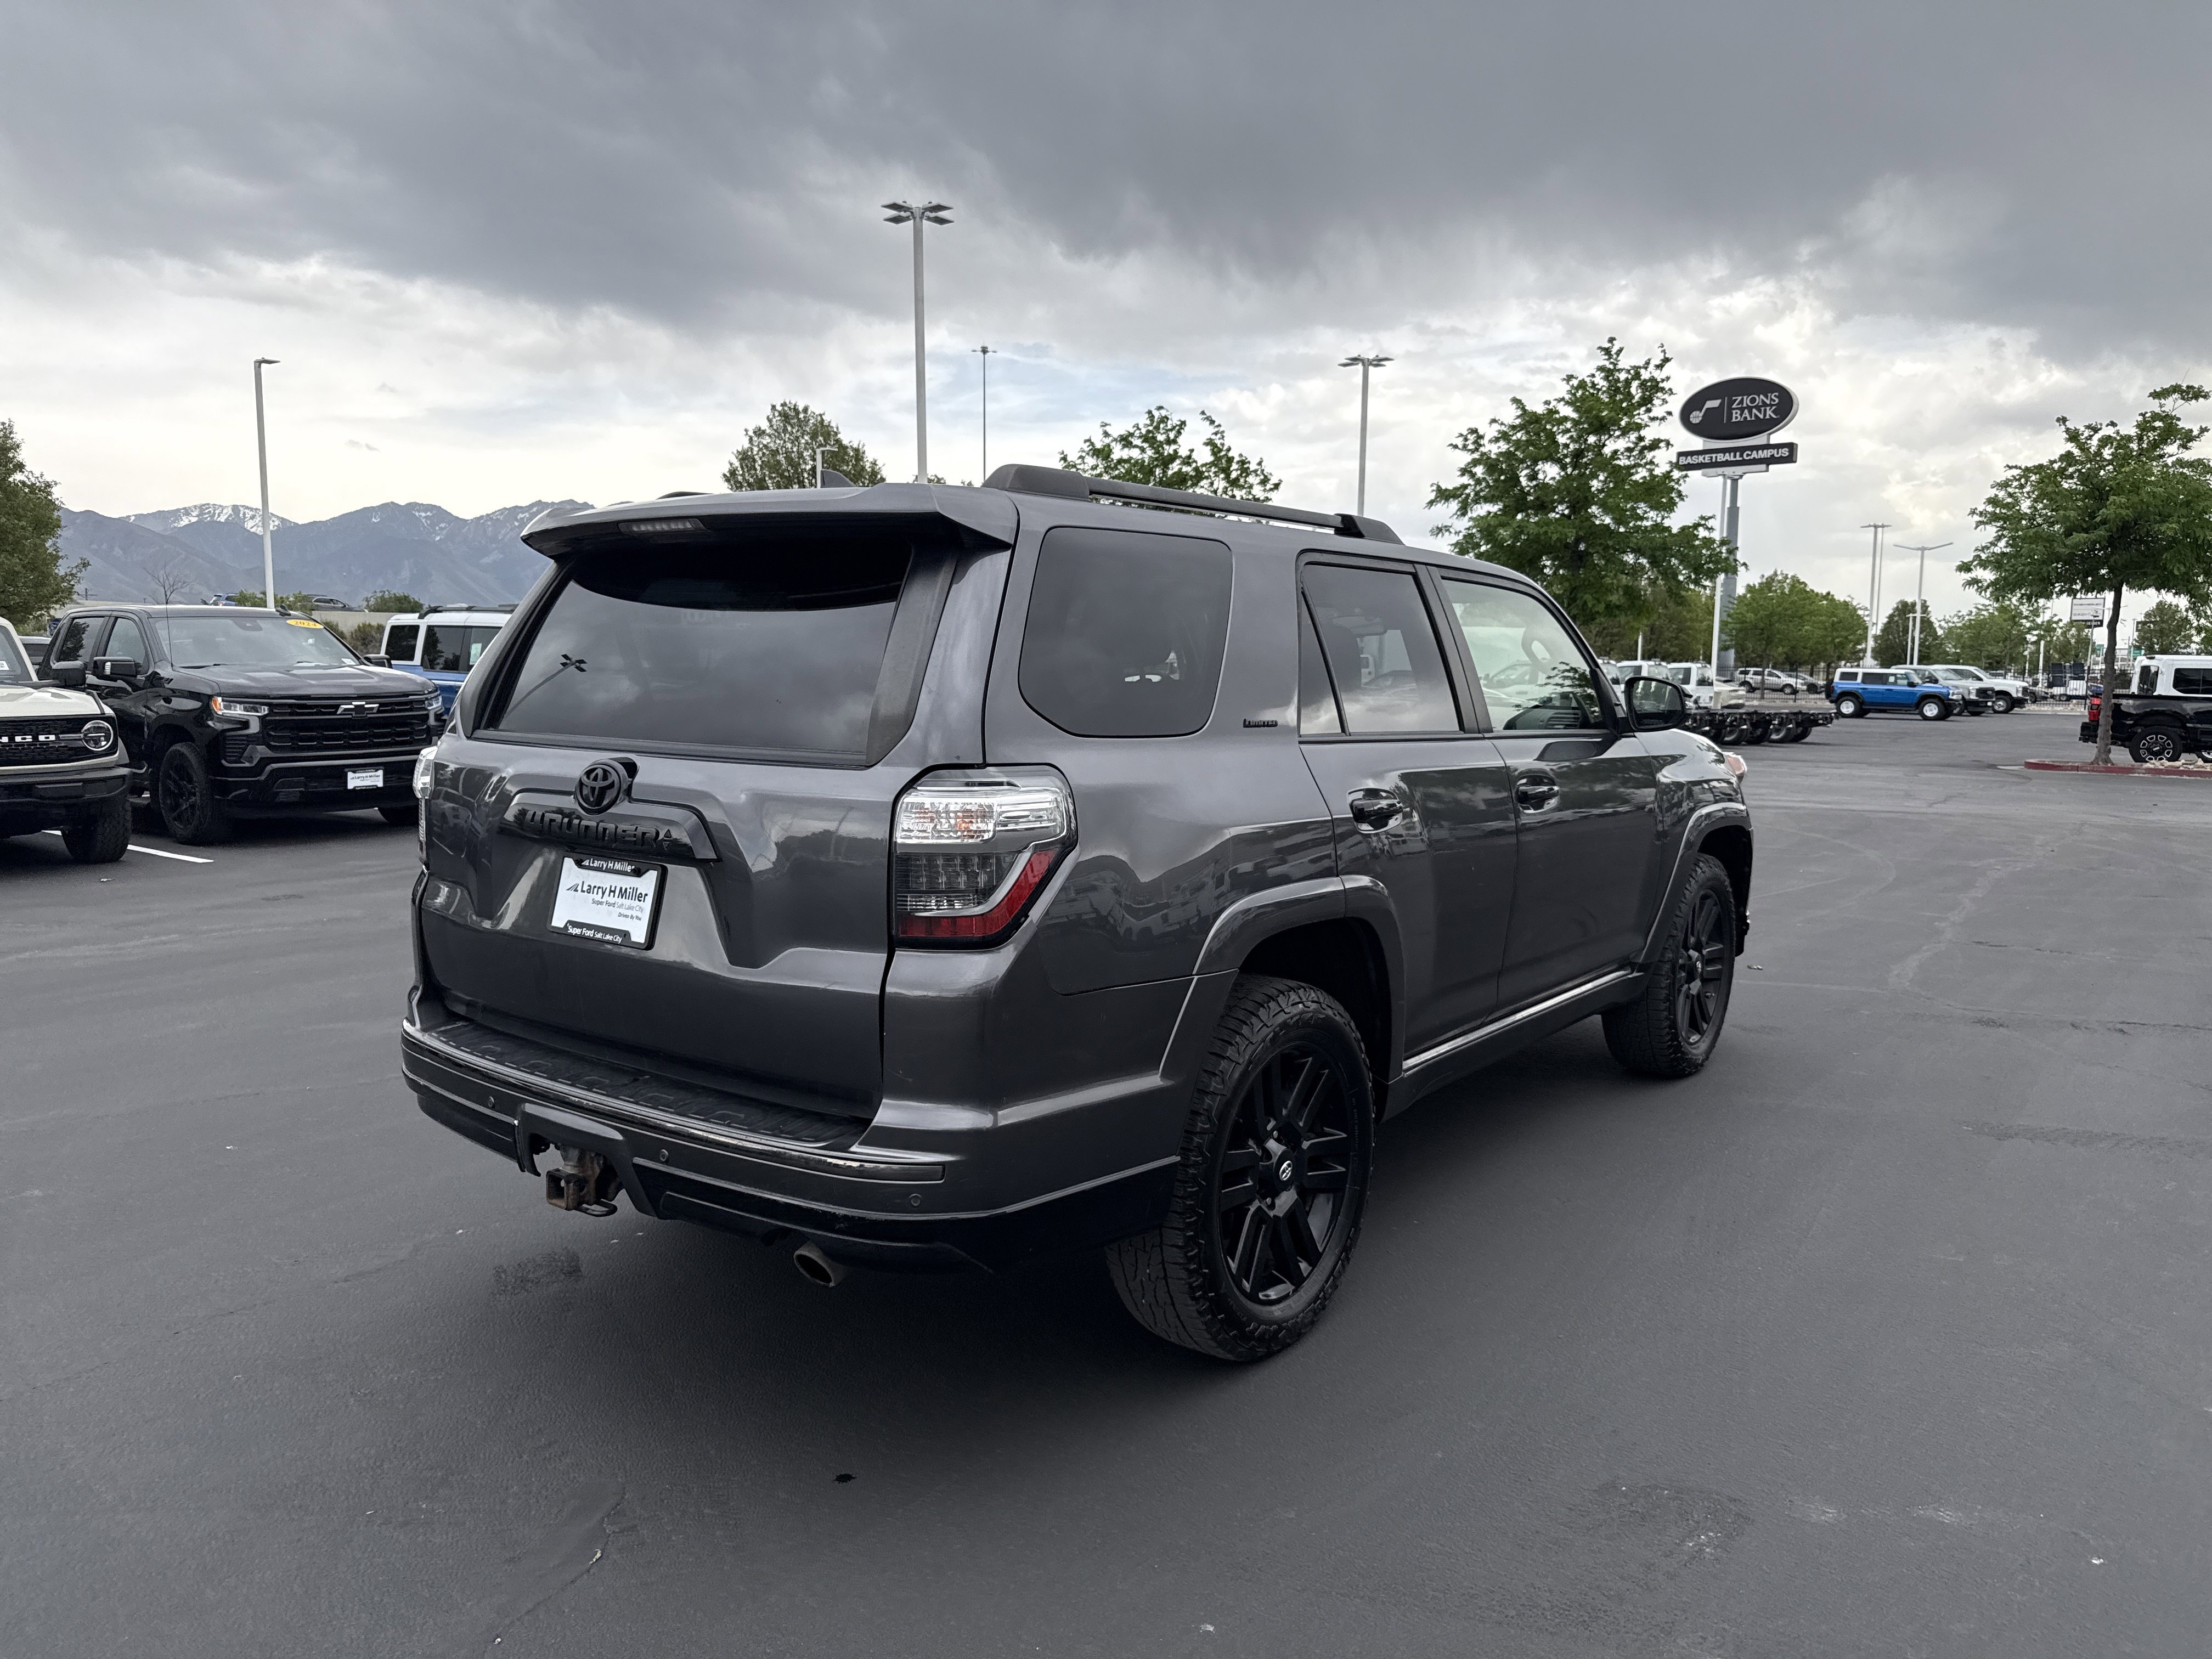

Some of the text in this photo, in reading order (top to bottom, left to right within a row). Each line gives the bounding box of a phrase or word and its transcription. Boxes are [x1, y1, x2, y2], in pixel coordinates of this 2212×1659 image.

[1731, 392, 1779, 408] ZIONS
[1731, 406, 1778, 422] BANK
[1679, 448, 1790, 465] BASKETBALL CAMPUS
[1243, 718, 1278, 728] LIMITED
[524, 810, 659, 848] 4RUNNER
[590, 857, 607, 870] Larry
[607, 860, 614, 869] H
[580, 881, 648, 903] Larry H Miller
[591, 898, 605, 906] Super
[624, 903, 635, 911] Lake
[635, 905, 644, 913] City
[567, 925, 582, 935] Super
[582, 928, 595, 937] Ford
[613, 934, 623, 944] City
